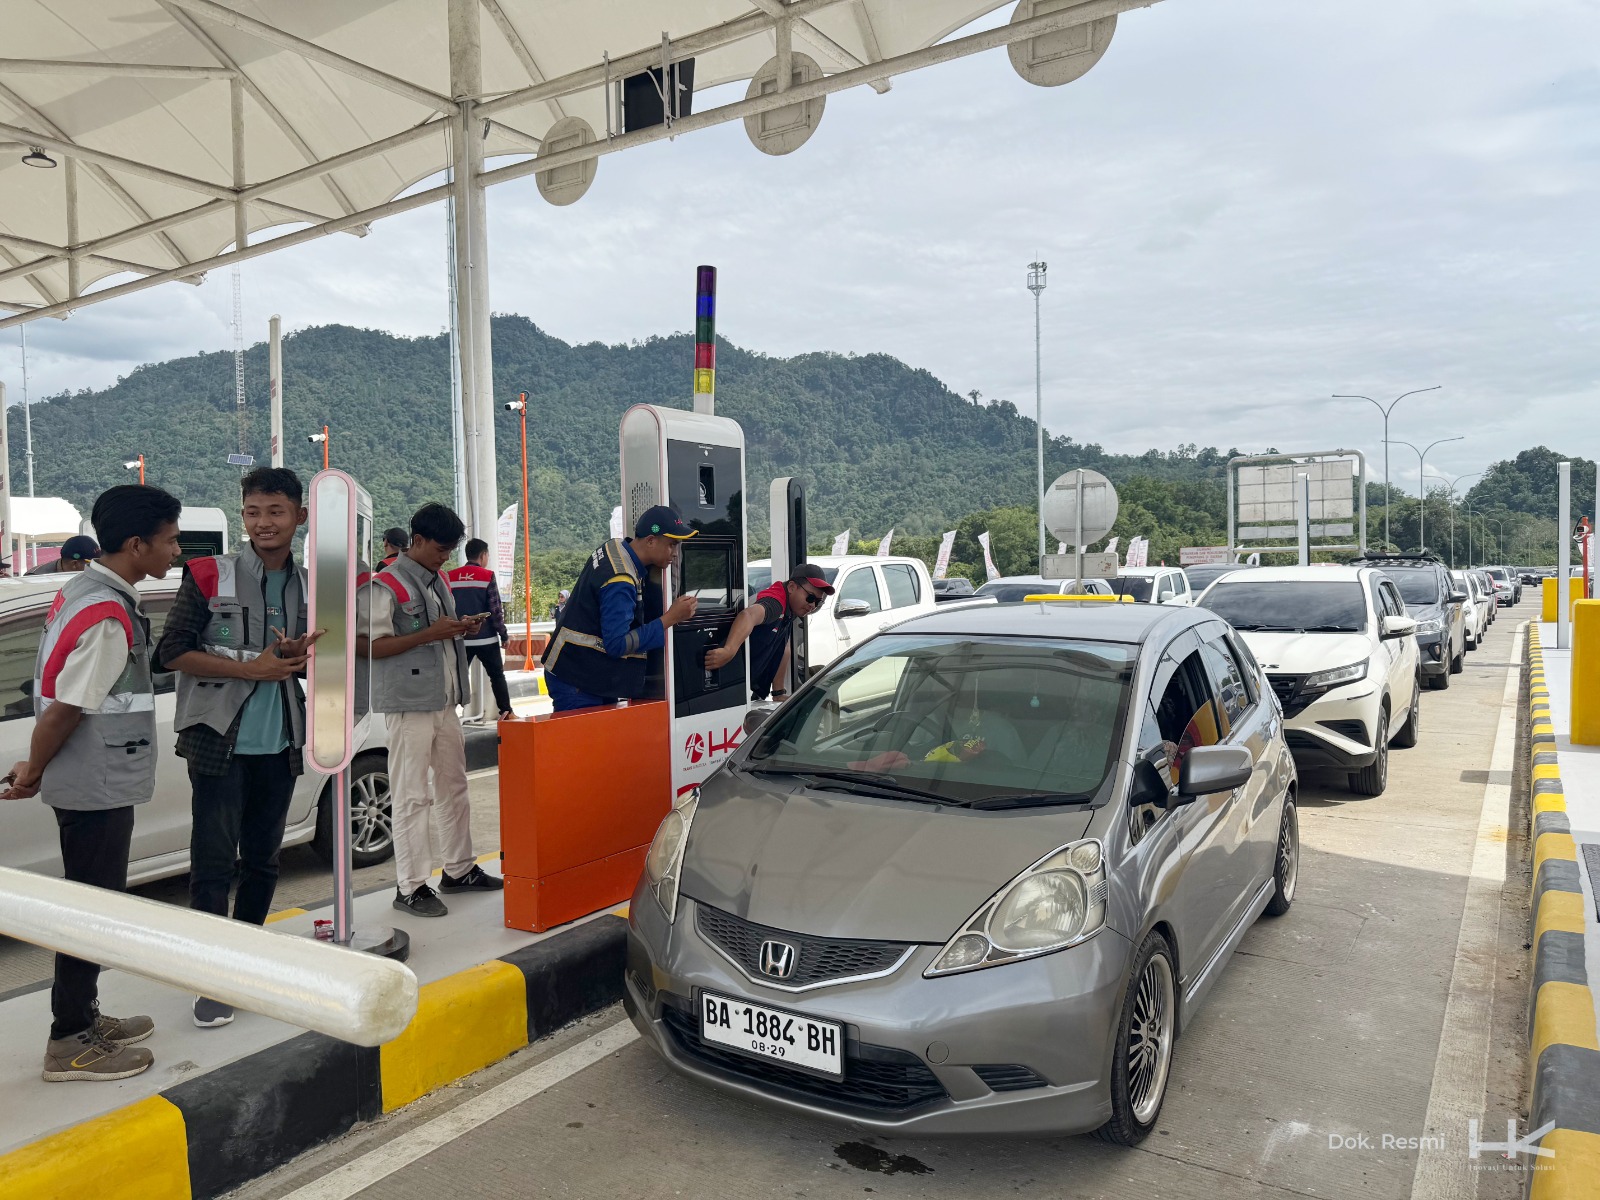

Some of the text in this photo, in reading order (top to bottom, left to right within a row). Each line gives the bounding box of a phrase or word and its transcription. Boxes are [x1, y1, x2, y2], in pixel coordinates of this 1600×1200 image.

[459, 572, 475, 581] HK
[708, 725, 742, 758] HK
[705, 998, 836, 1056] BA 1884 BH
